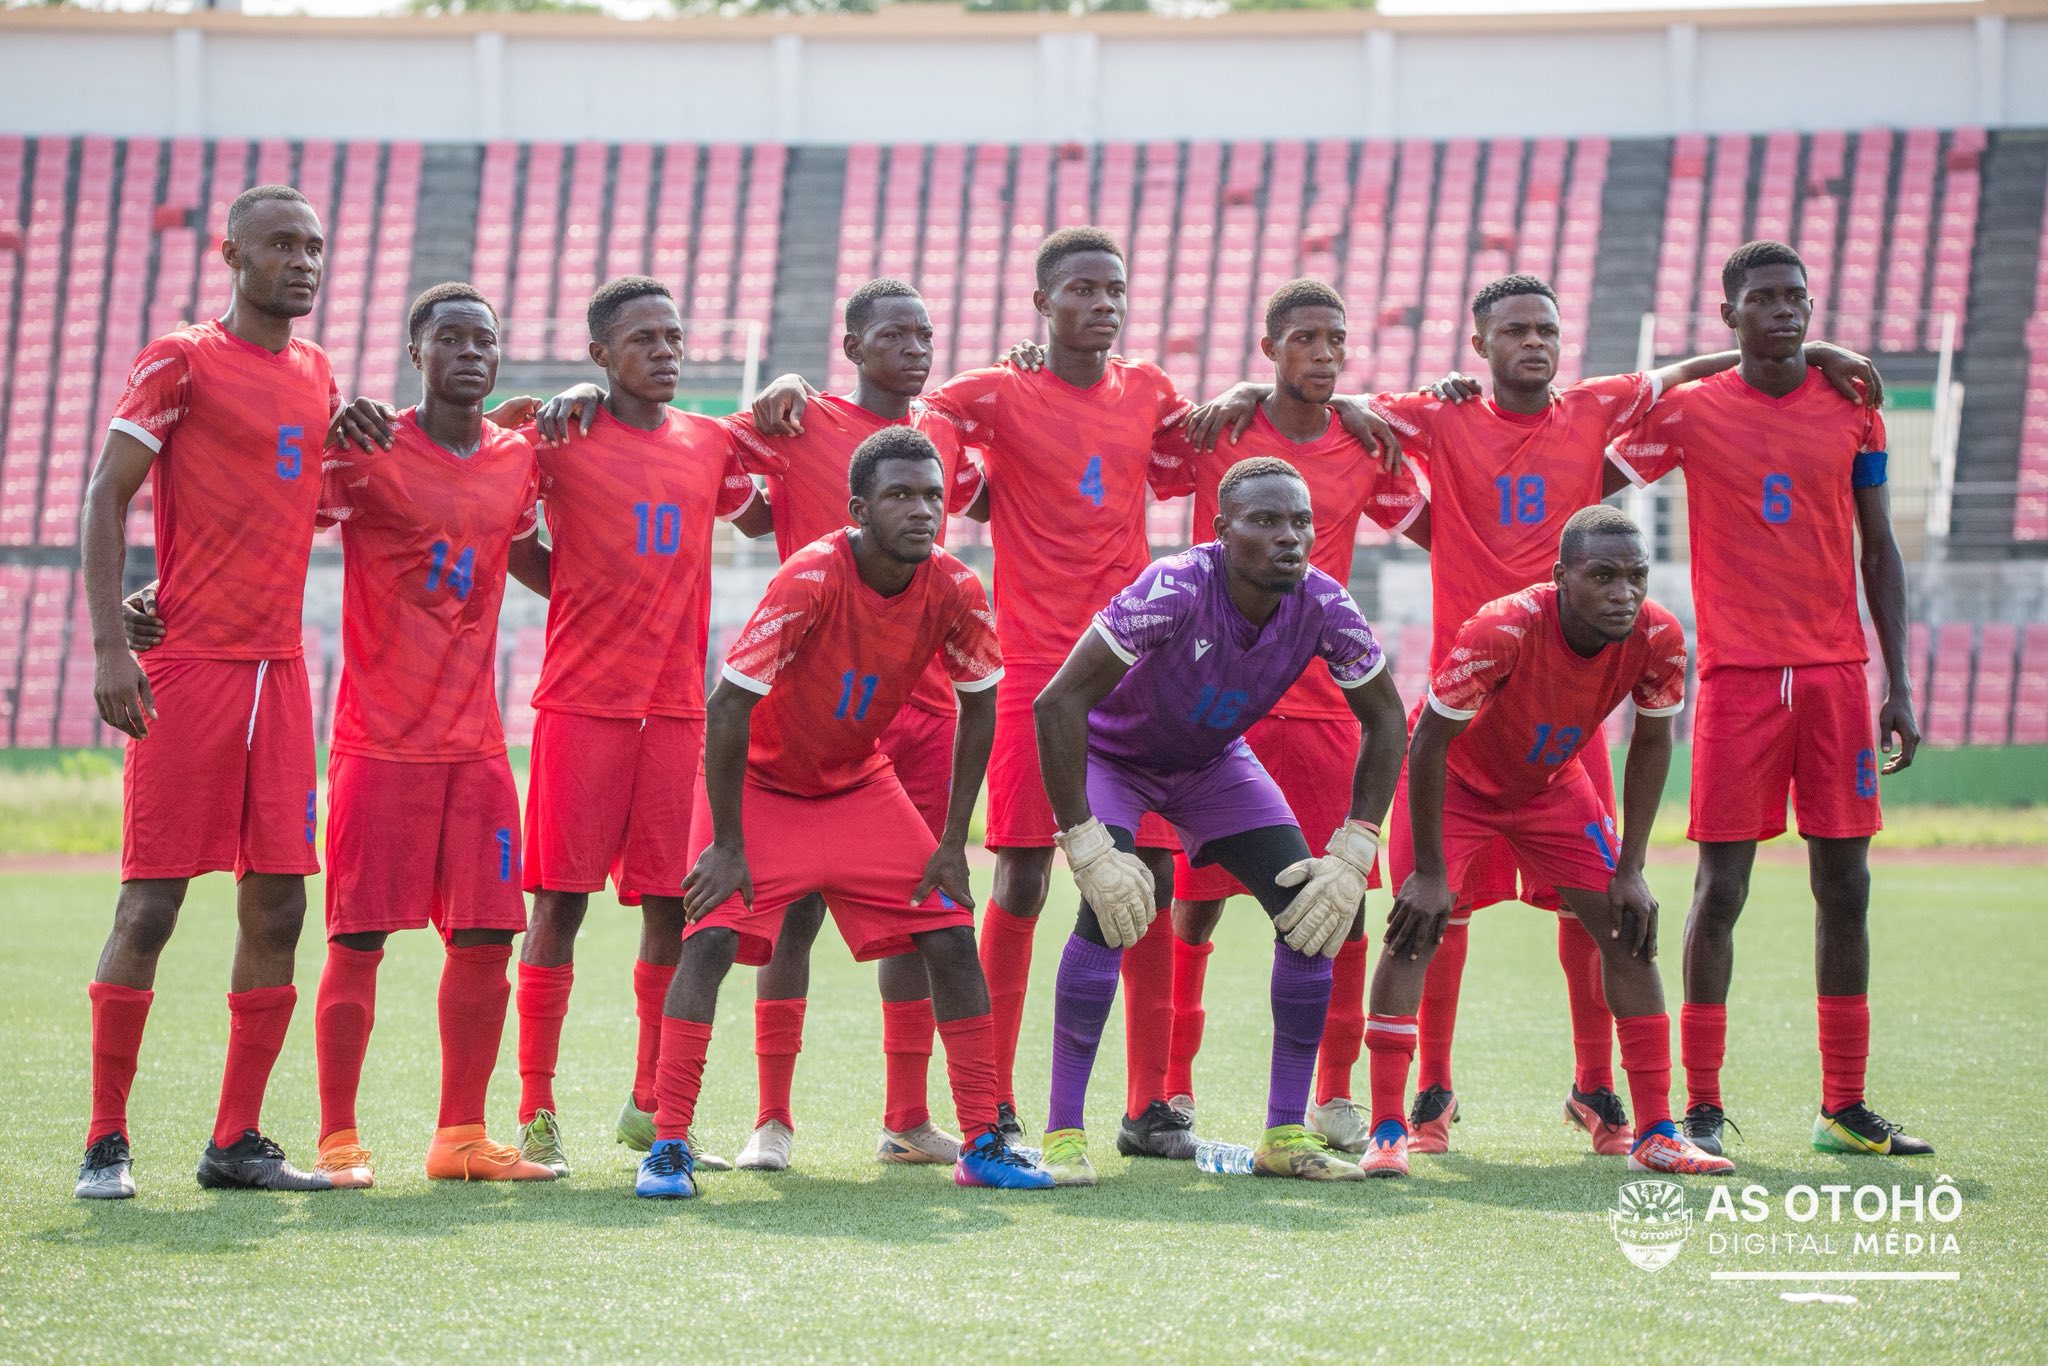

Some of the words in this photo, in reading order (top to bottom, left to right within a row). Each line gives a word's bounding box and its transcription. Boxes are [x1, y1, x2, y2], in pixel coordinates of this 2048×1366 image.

[276, 425, 303, 479] 5
[1080, 455, 1105, 506] 4
[1495, 475, 1545, 526] 18
[1762, 473, 1792, 523] 6
[632, 503, 681, 555] 10
[425, 541, 475, 600] 14
[834, 670, 879, 720] 11
[1189, 684, 1248, 729] 16
[1526, 722, 1580, 761] 13
[1855, 749, 1877, 798] 6
